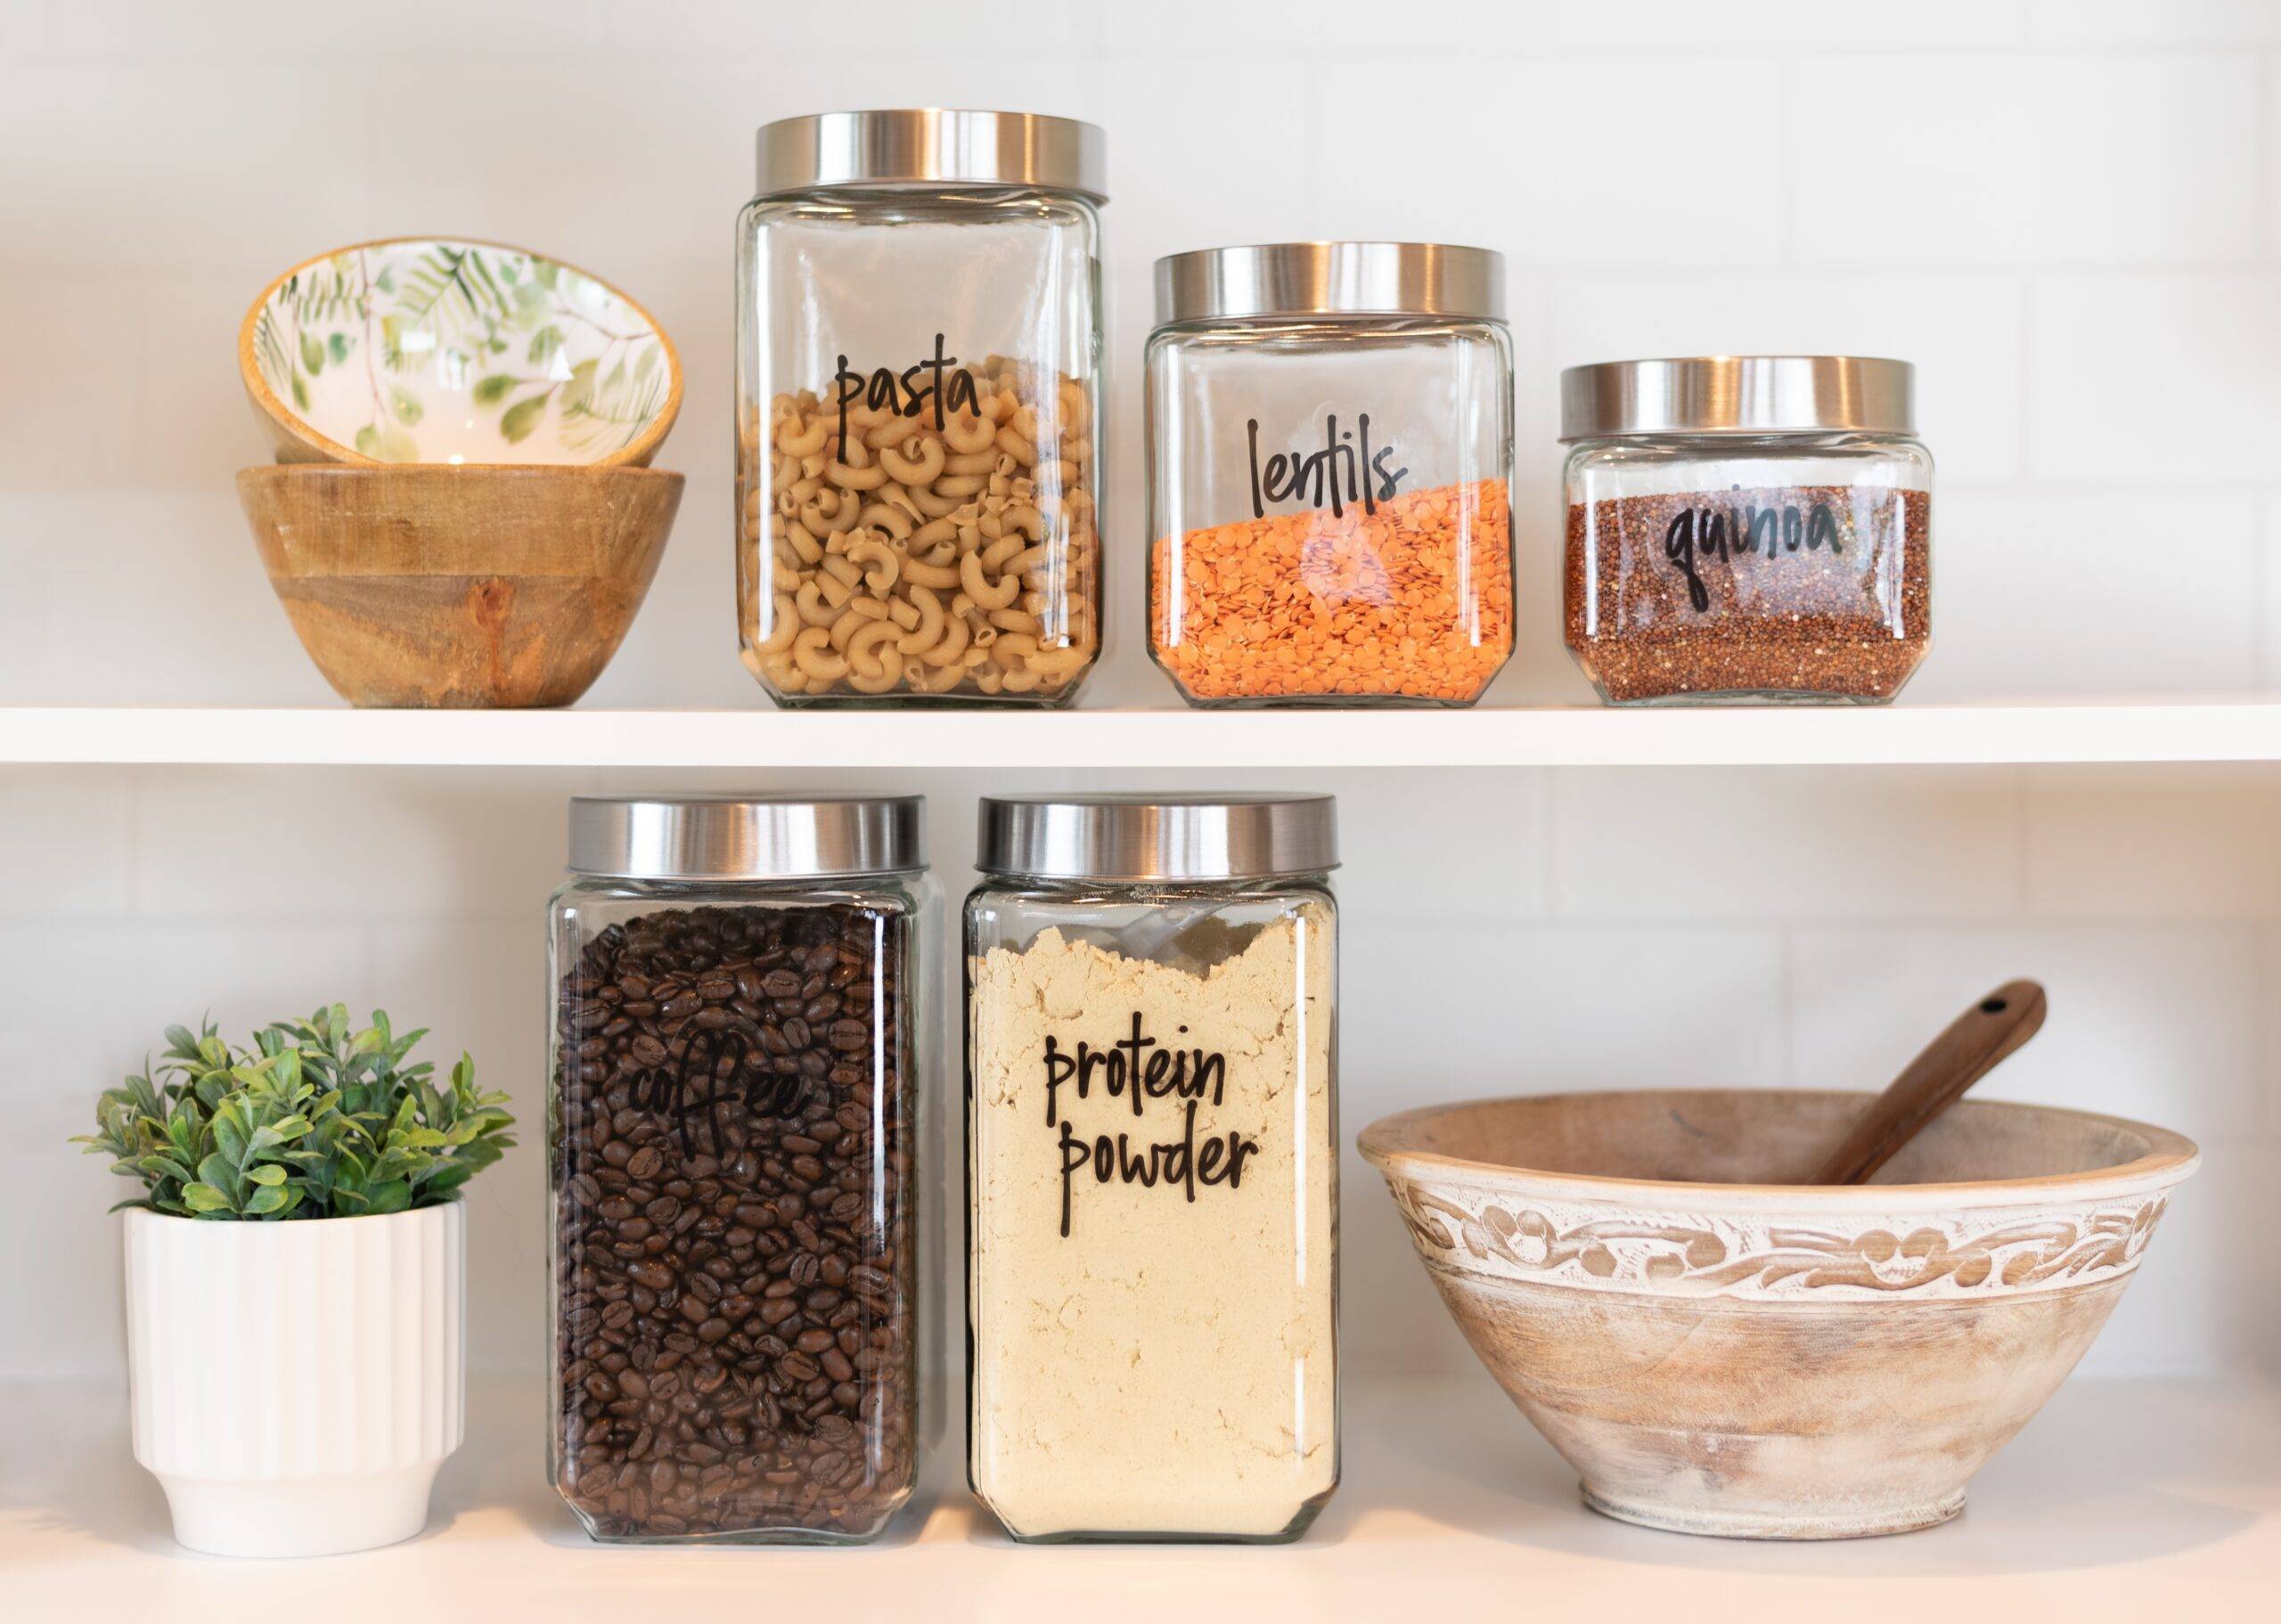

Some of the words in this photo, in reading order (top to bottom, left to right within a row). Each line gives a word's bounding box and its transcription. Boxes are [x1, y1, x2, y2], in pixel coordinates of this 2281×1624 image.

[836, 333, 981, 465] pasta
[1247, 413, 1408, 518] lentils
[1665, 484, 1842, 612] quinoa
[628, 1027, 813, 1163] coffee
[1044, 1012, 1225, 1128] protein
[1059, 1100, 1258, 1236] powder
